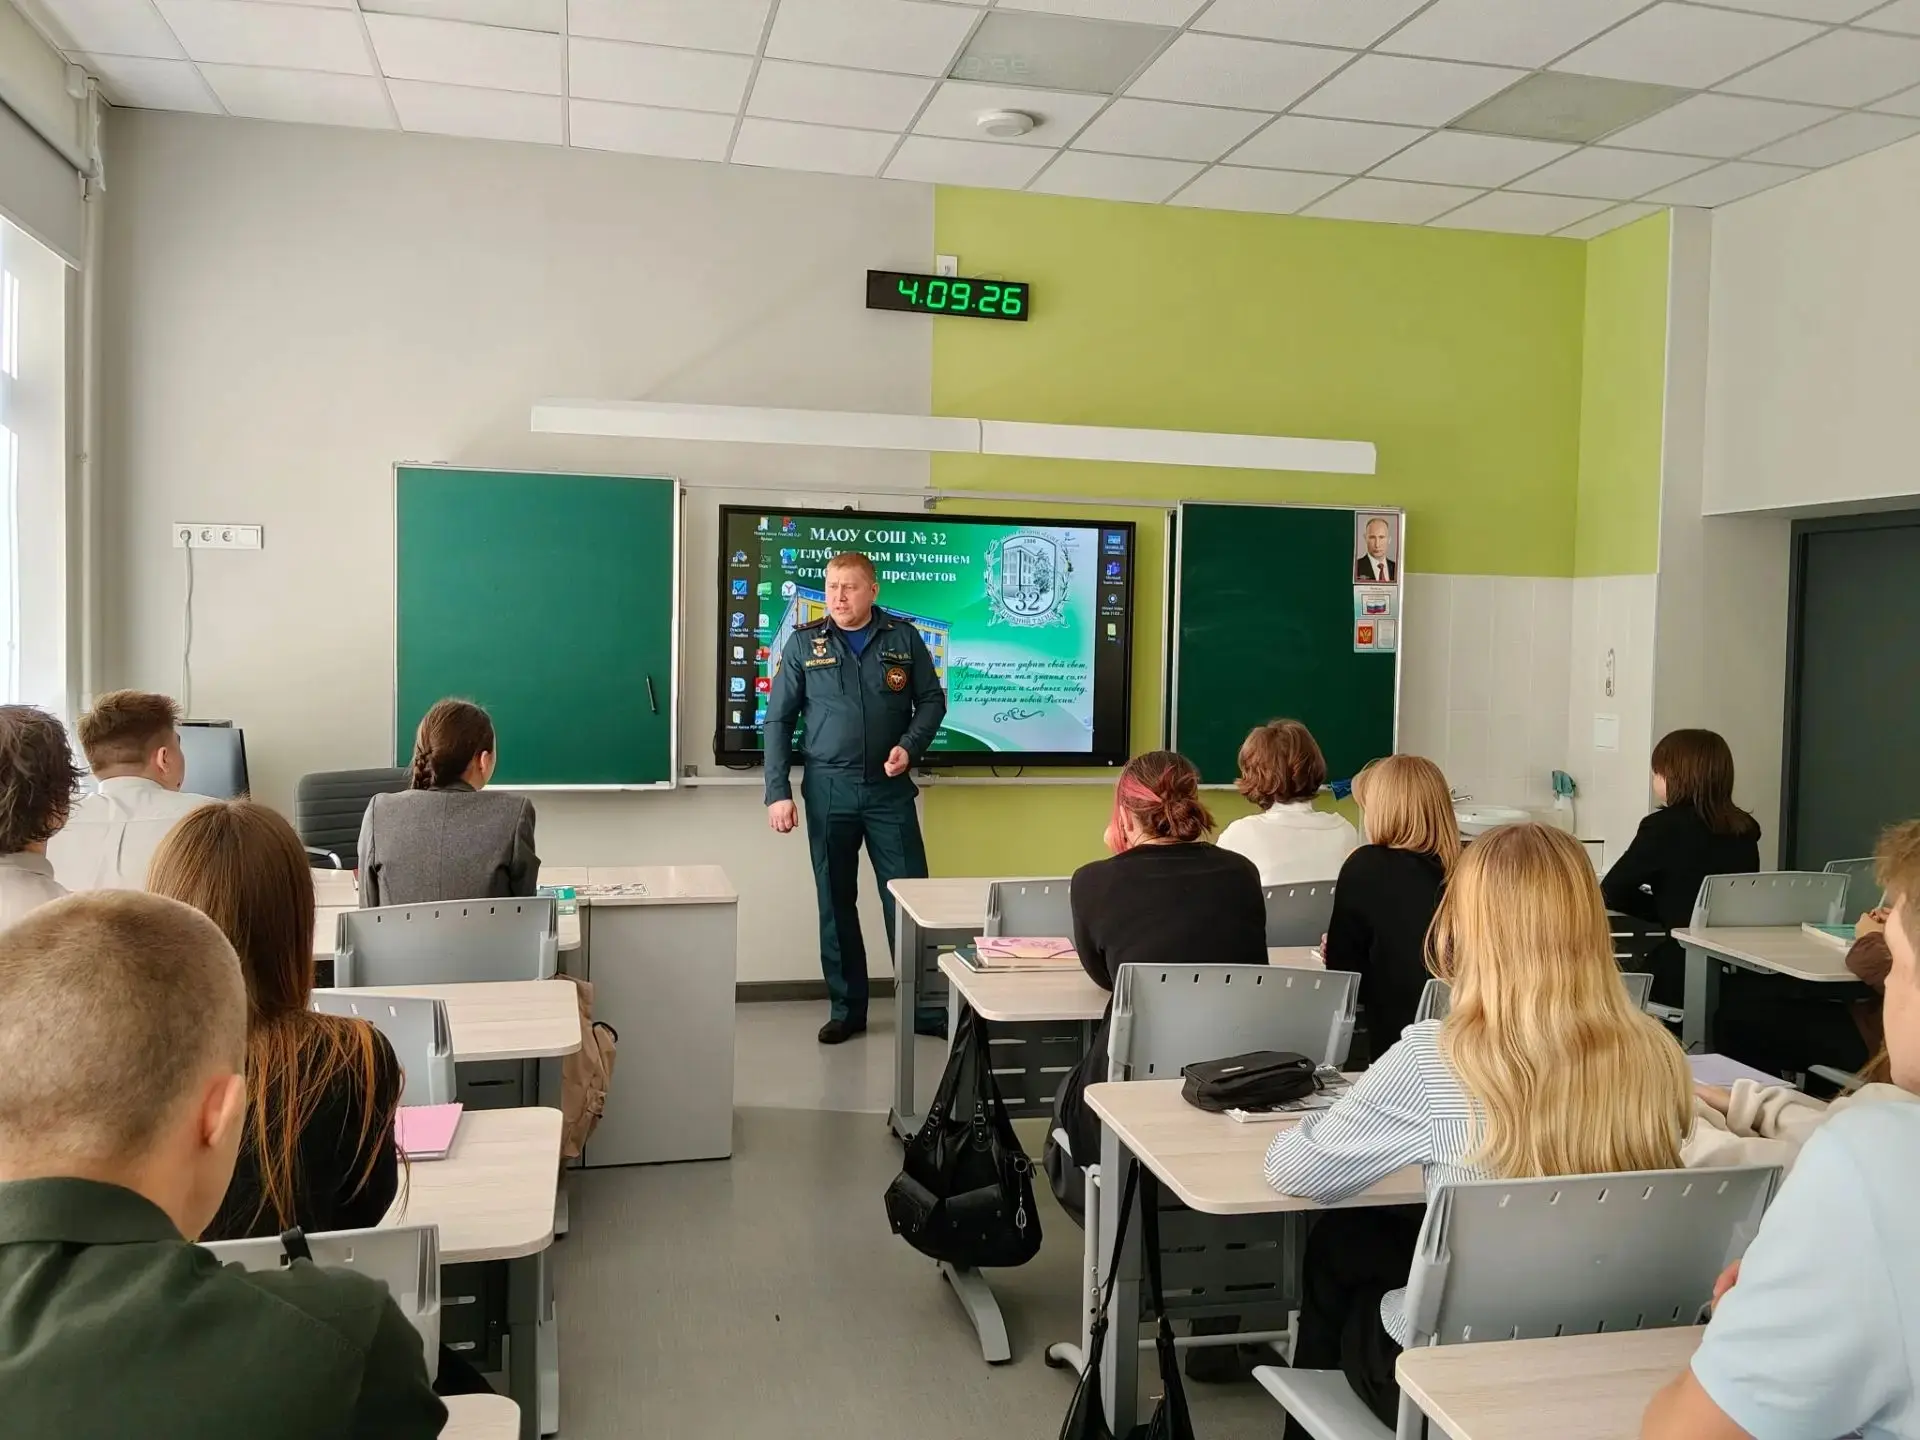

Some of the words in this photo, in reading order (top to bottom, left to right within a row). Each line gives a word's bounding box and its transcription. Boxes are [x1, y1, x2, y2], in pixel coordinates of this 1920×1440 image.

[898, 279, 1022, 314] 4.09.26
[810, 527, 861, 542] МАОУ
[864, 530, 906, 544] СОШ
[910, 531, 927, 545] №
[930, 532, 947, 546] 32
[895, 552, 970, 566] изучением
[882, 570, 957, 584] предметов
[1015, 591, 1041, 612] 32
[953, 656, 986, 669] Пусть
[1016, 660, 1045, 671] дарит
[1047, 659, 1065, 668] свой
[1033, 674, 1065, 683] знания
[953, 681, 973, 691] Для
[953, 692, 973, 702] Для
[975, 697, 1017, 706] служения
[1019, 694, 1042, 703] новой
